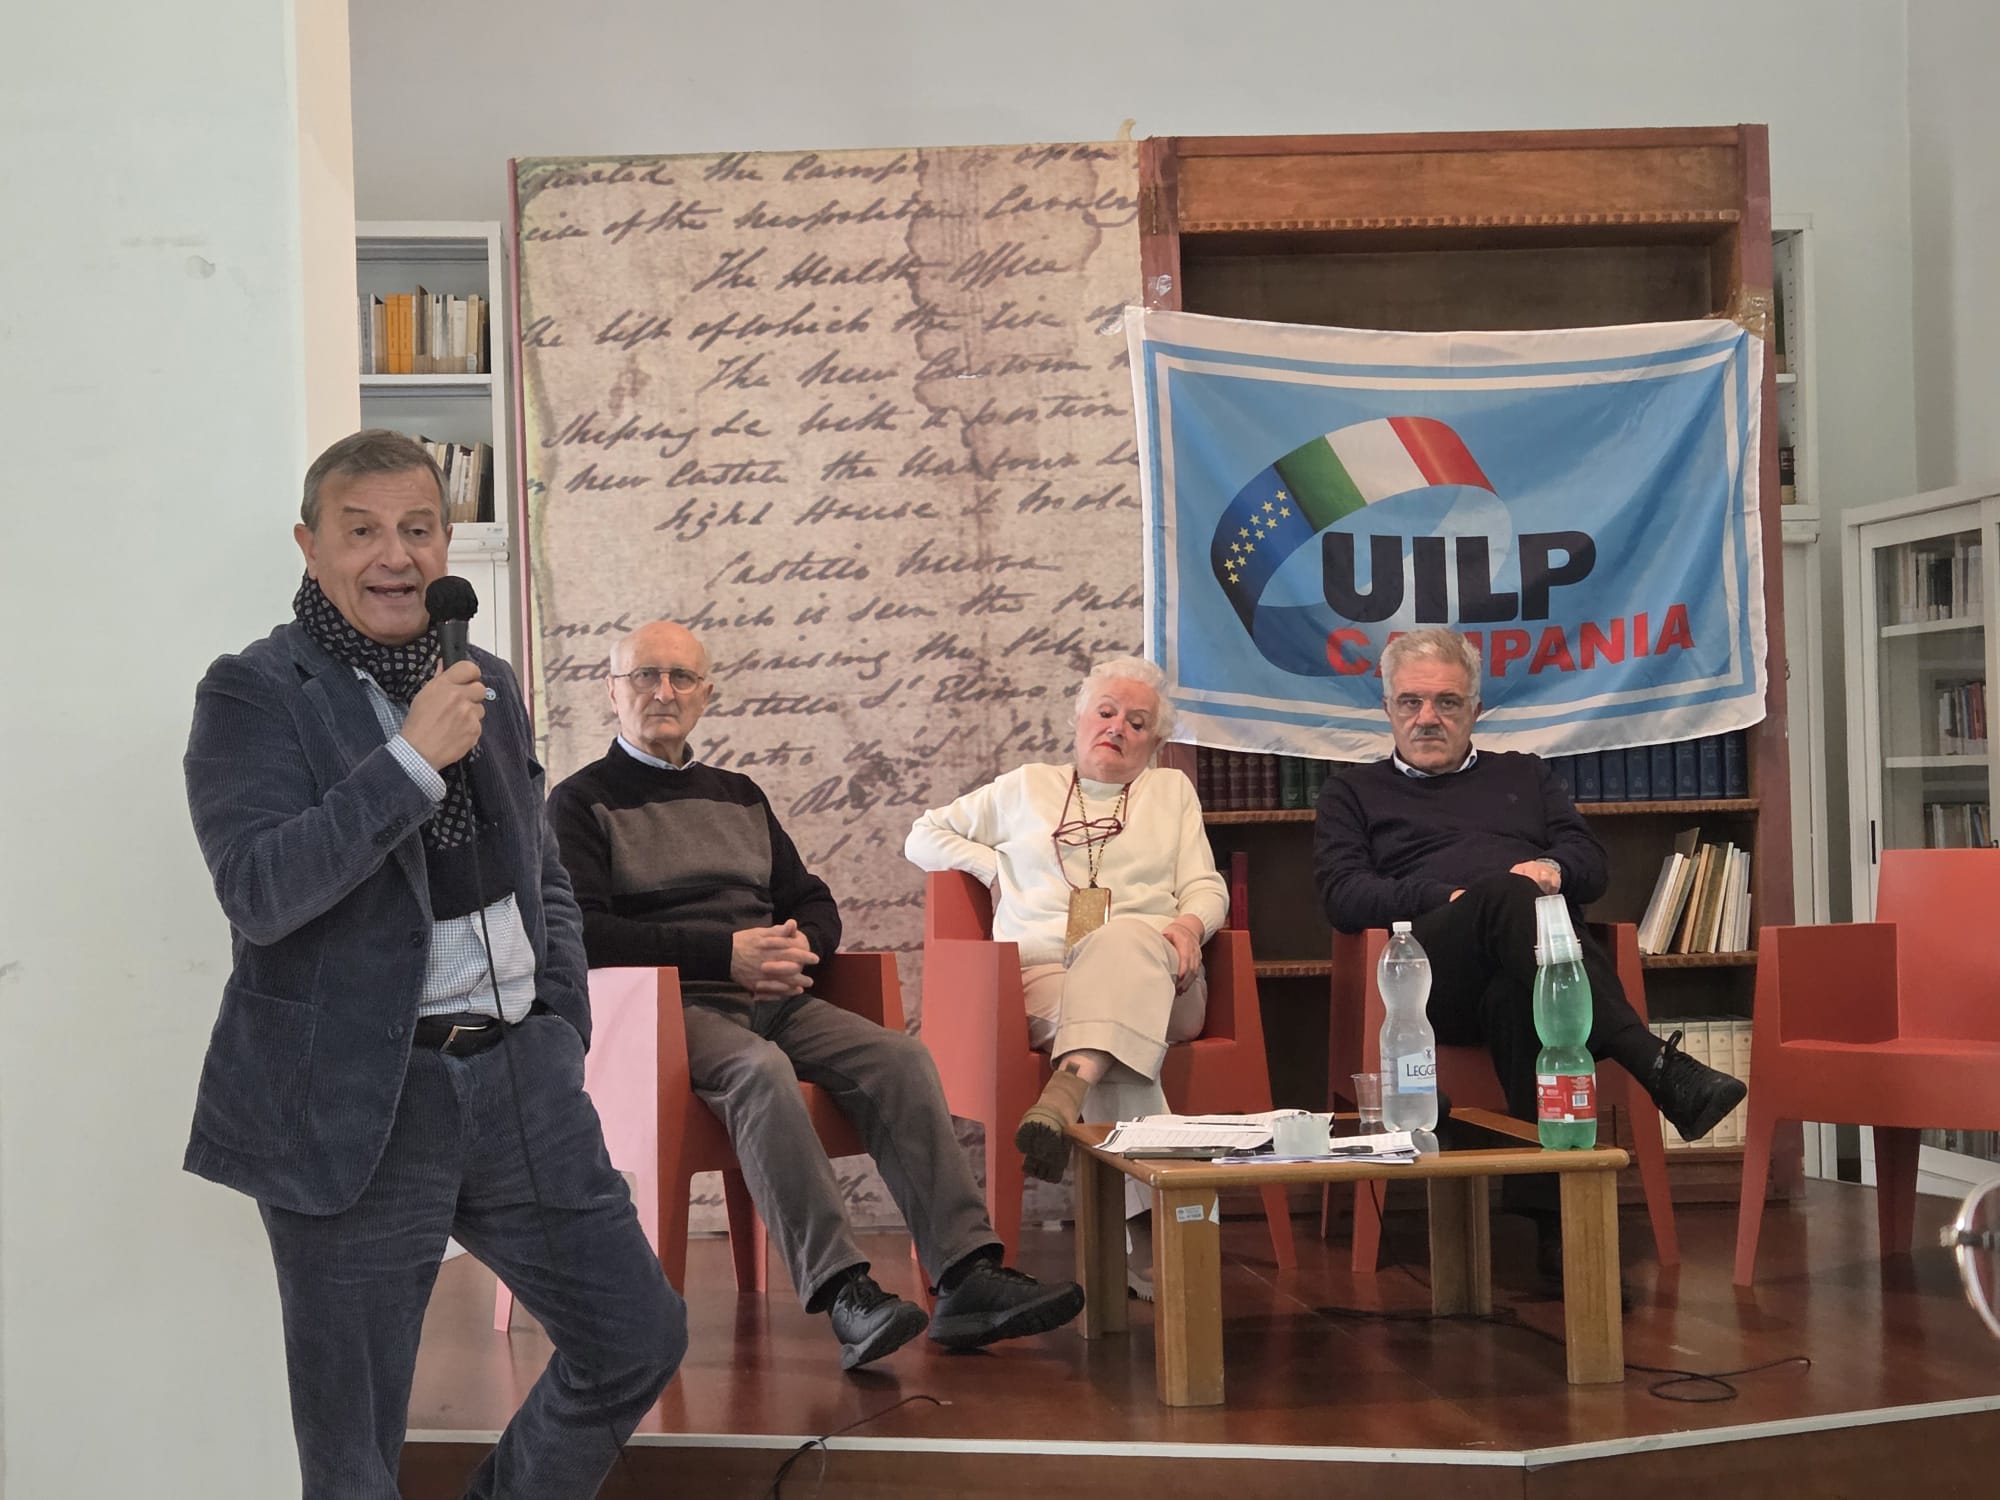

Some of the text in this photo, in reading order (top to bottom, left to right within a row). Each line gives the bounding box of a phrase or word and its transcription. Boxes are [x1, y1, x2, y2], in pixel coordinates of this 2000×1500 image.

[691, 236, 1072, 293] The Health Office
[695, 351, 771, 397] The
[793, 494, 940, 526] House
[1322, 530, 1596, 624] UILP
[661, 598, 775, 632] hich
